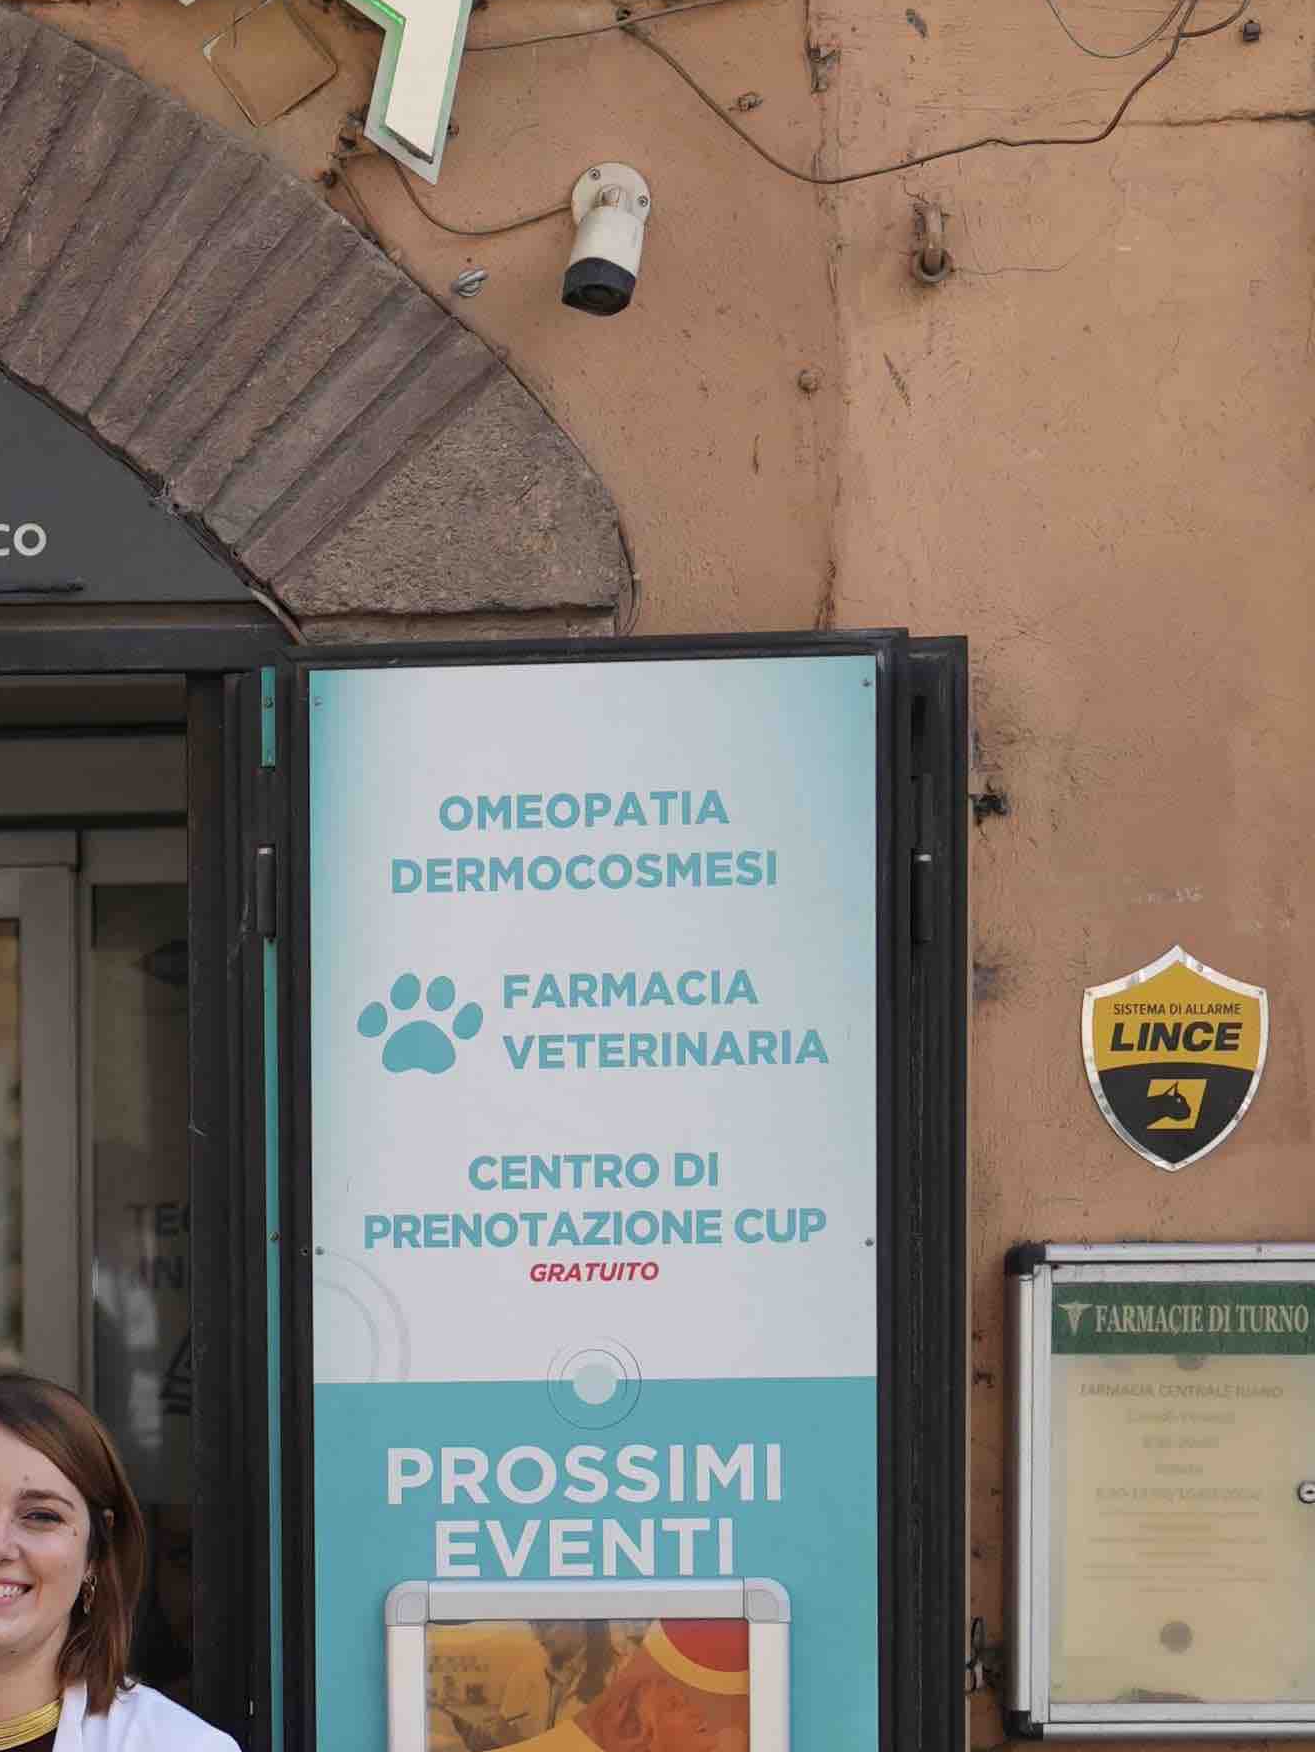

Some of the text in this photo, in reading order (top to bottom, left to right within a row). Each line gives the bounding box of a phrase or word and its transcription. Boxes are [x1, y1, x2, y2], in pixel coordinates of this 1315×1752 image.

[438, 789, 731, 832] OMEOPATIA
[391, 850, 778, 895] DERMOCOSMESI
[503, 969, 759, 1009] FARMACIA
[1114, 1002, 1242, 1016] SISTEMA DI ALLARME
[503, 1029, 830, 1070] VETERINARIA
[1110, 1021, 1244, 1052] LINCE
[467, 1151, 719, 1191] CENTRO DI
[363, 1207, 828, 1249] PRENOTAZIONE CUP
[529, 1261, 660, 1283] GRATUITO
[1095, 1303, 1310, 1334] FARMACIE DI TURNO
[386, 1443, 783, 1506] PROSSIMI
[433, 1517, 735, 1578] EVENTI
